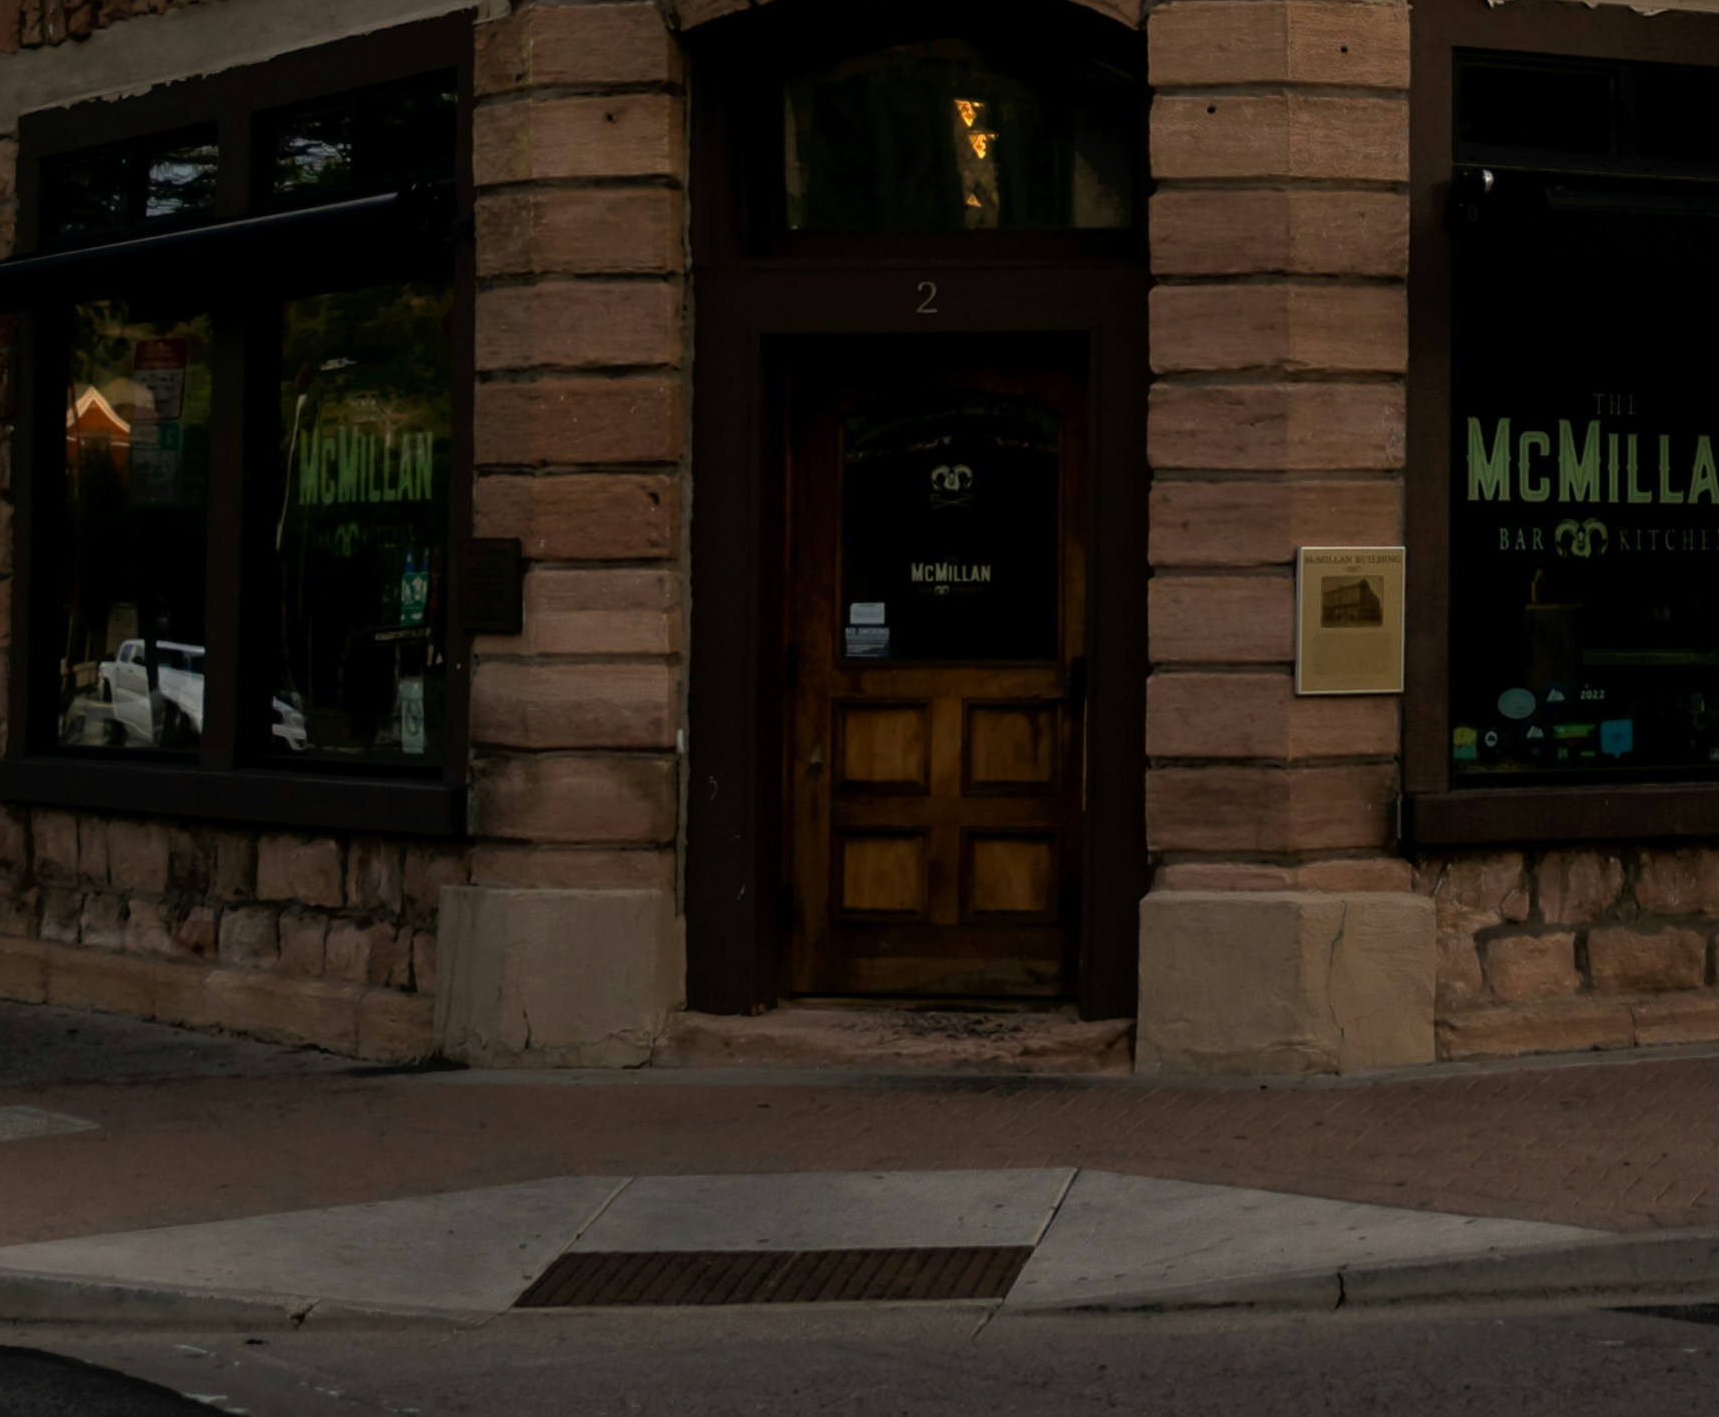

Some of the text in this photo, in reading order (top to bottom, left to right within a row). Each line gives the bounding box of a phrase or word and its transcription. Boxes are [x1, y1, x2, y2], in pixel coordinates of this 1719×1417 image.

[916, 280, 939, 314] 2
[1593, 393, 1639, 416] THE
[1498, 527, 1545, 552] BAR
[1579, 688, 1606, 700] 2022
